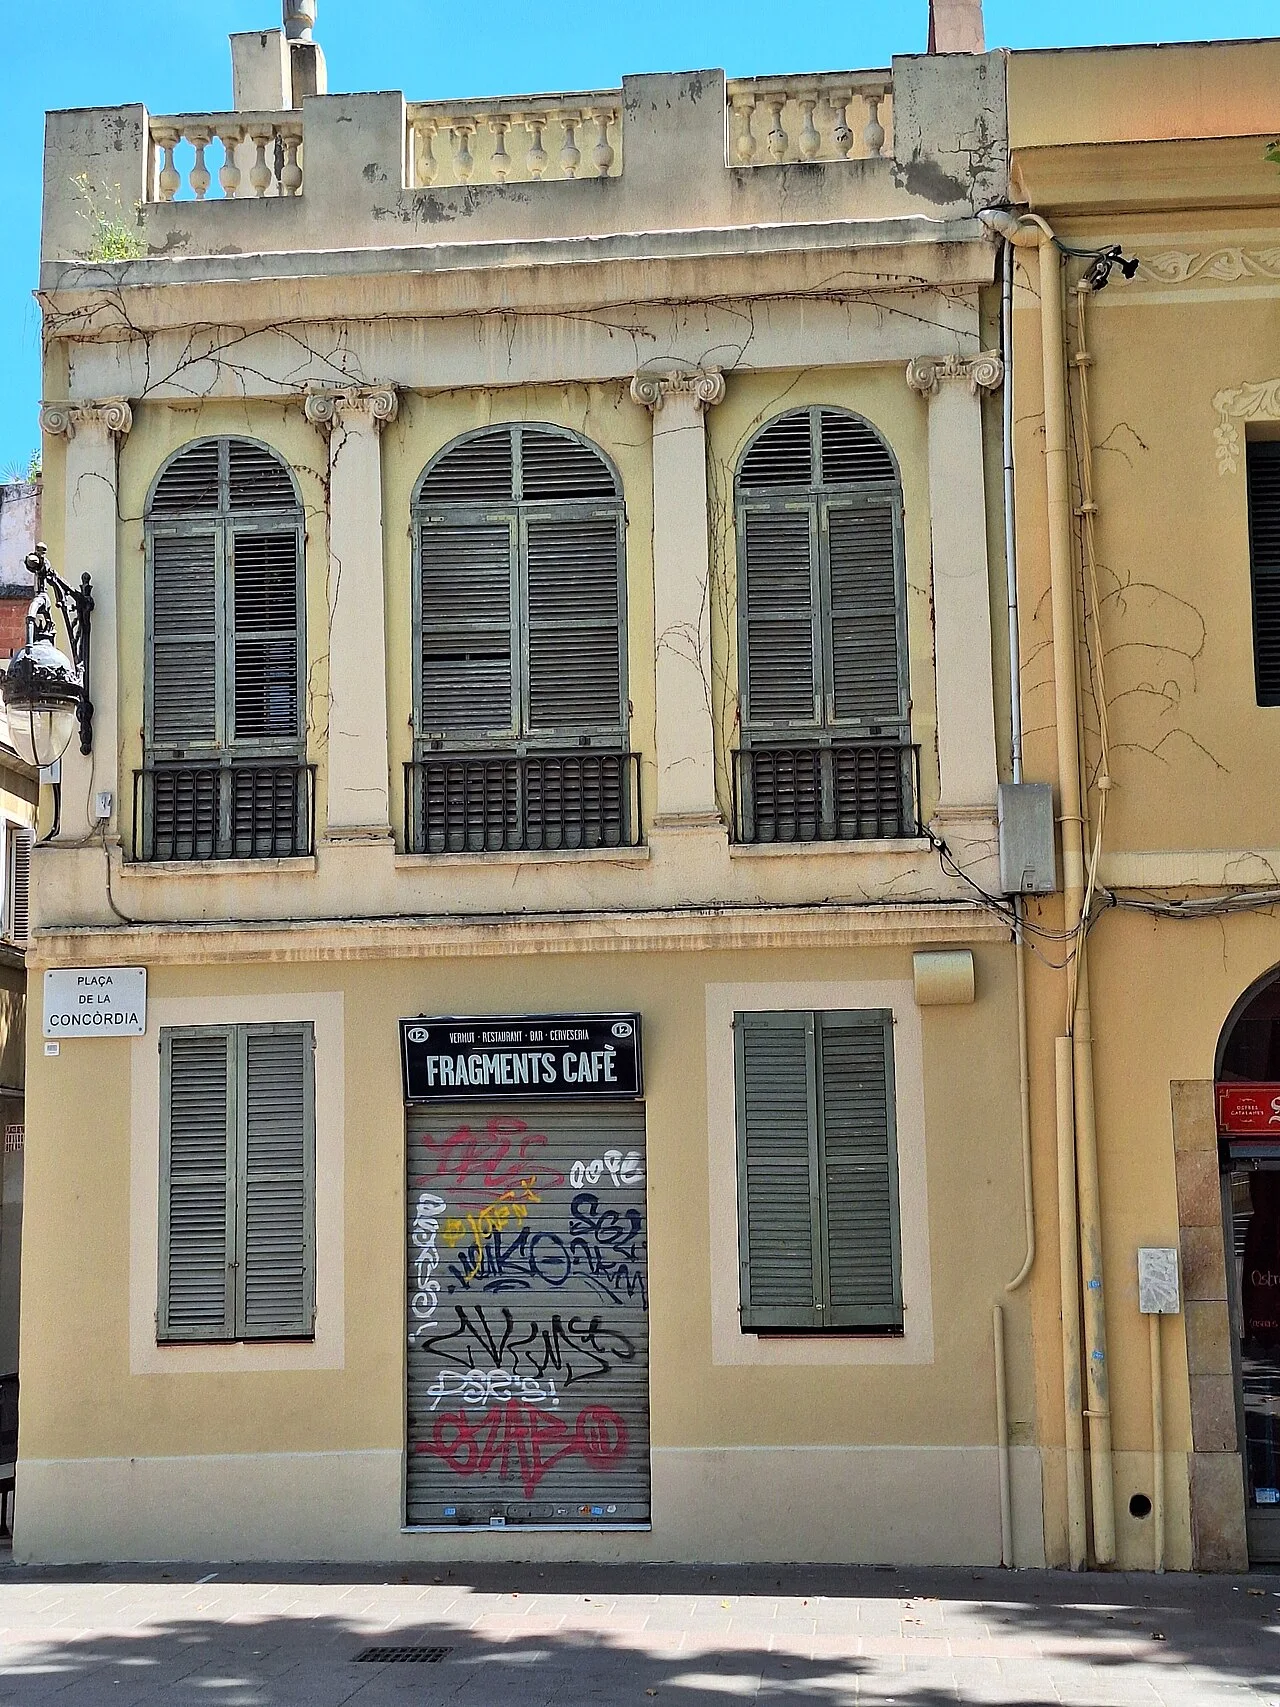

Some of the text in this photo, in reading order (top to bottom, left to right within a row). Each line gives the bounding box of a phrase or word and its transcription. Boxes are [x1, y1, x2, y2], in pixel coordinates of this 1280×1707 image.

[77, 976, 113, 987] PLAÇA
[79, 994, 111, 1004] DE LA
[50, 1011, 138, 1026] CONCÒRDIA
[411, 1030, 426, 1040] 12
[615, 1025, 628, 1035] 12
[450, 1029, 590, 1043] VERMUT RESTAURANT BAR CERVESERIA
[426, 1044, 618, 1086] FRAGMENTS CAFÈ
